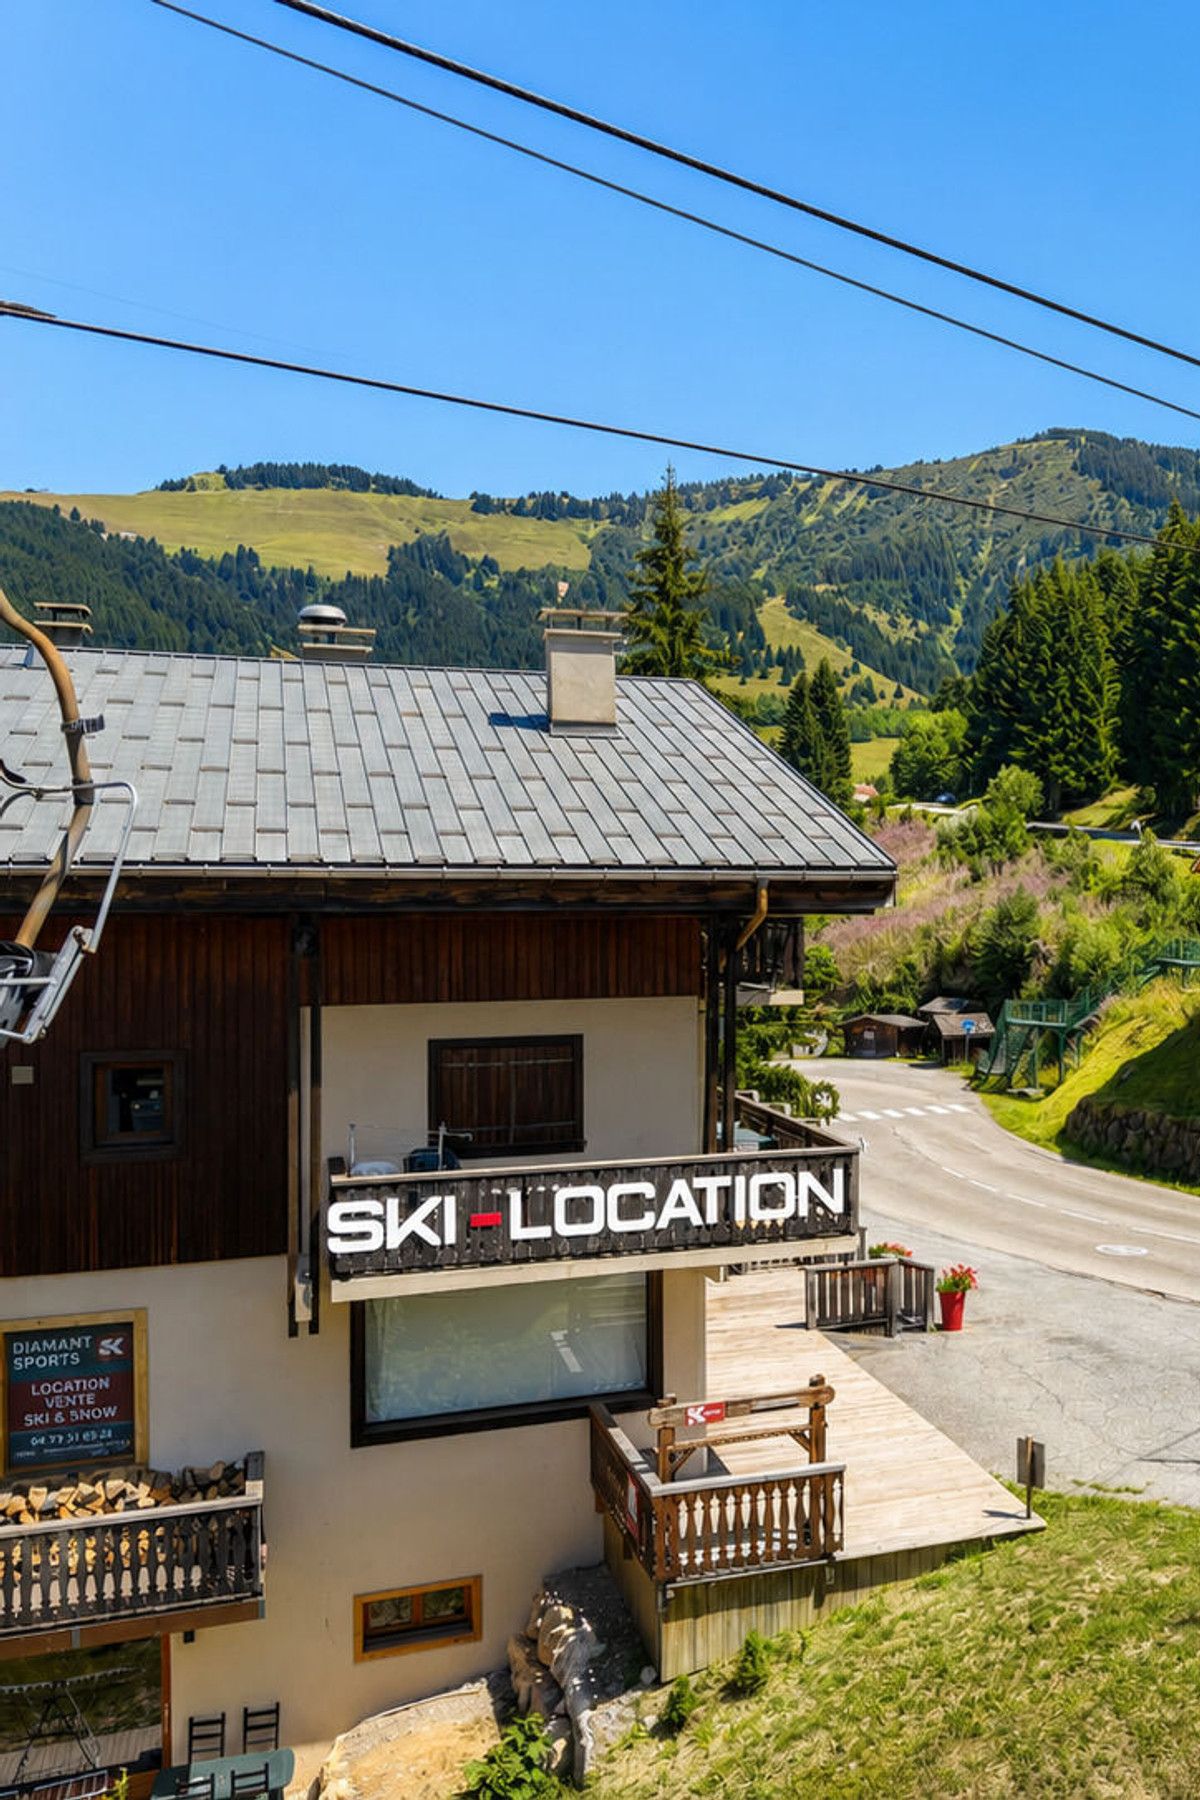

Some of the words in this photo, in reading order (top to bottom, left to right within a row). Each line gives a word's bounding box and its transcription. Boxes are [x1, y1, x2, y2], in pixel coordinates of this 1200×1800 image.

[327, 1195, 455, 1254] SKI
[509, 1167, 845, 1241] LOCATION
[13, 1335, 92, 1355] DIAMANT
[13, 1352, 81, 1371] SPORTS
[31, 1376, 110, 1396] LOCATION
[45, 1393, 96, 1409] VENTE
[24, 1411, 49, 1427] SKI
[69, 1405, 118, 1422] SNOW
